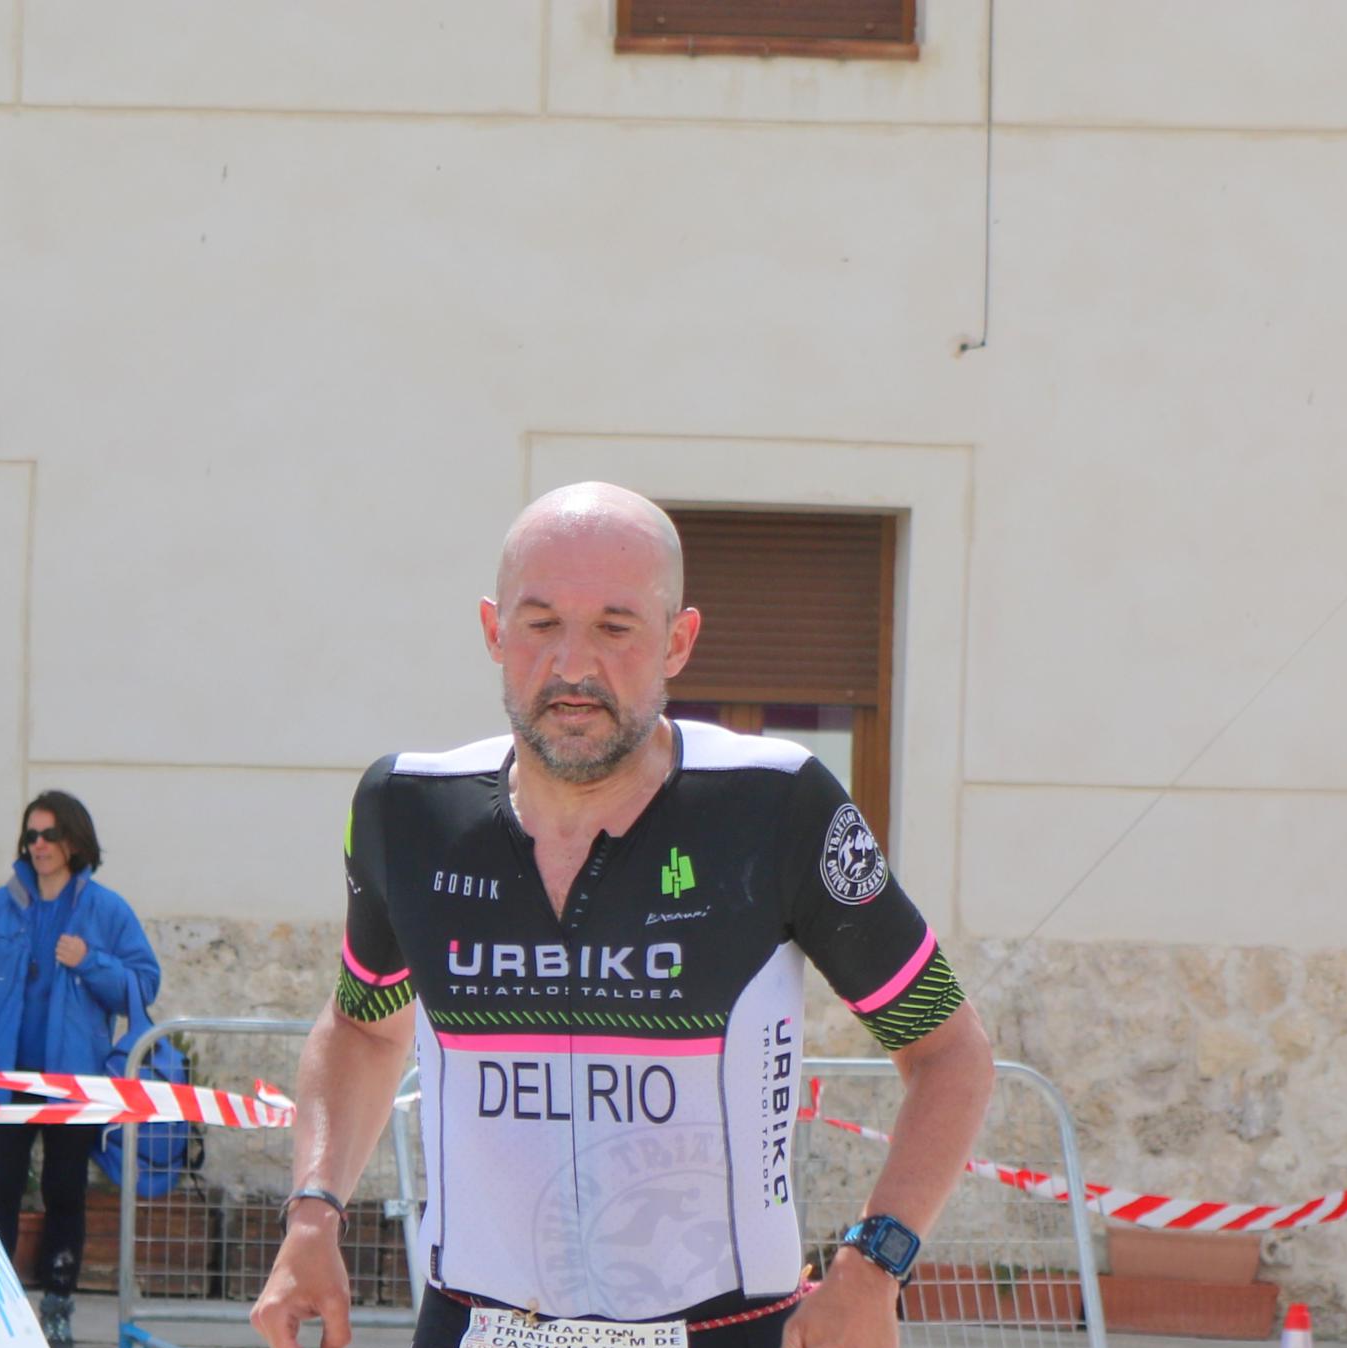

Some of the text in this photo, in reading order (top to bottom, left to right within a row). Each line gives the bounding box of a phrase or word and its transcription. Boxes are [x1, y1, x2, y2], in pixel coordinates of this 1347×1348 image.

[433, 871, 499, 900] GOBIK
[448, 939, 683, 980] URBIKO
[581, 986, 684, 1000] TALDEA
[478, 1060, 677, 1124] DEL RIO
[772, 1016, 793, 1206] URBIKO
[761, 1126, 771, 1210] TALDEA
[494, 1325, 584, 1344] TRIATLON
[592, 1336, 603, 1345] Y
[654, 1337, 681, 1346] DE
